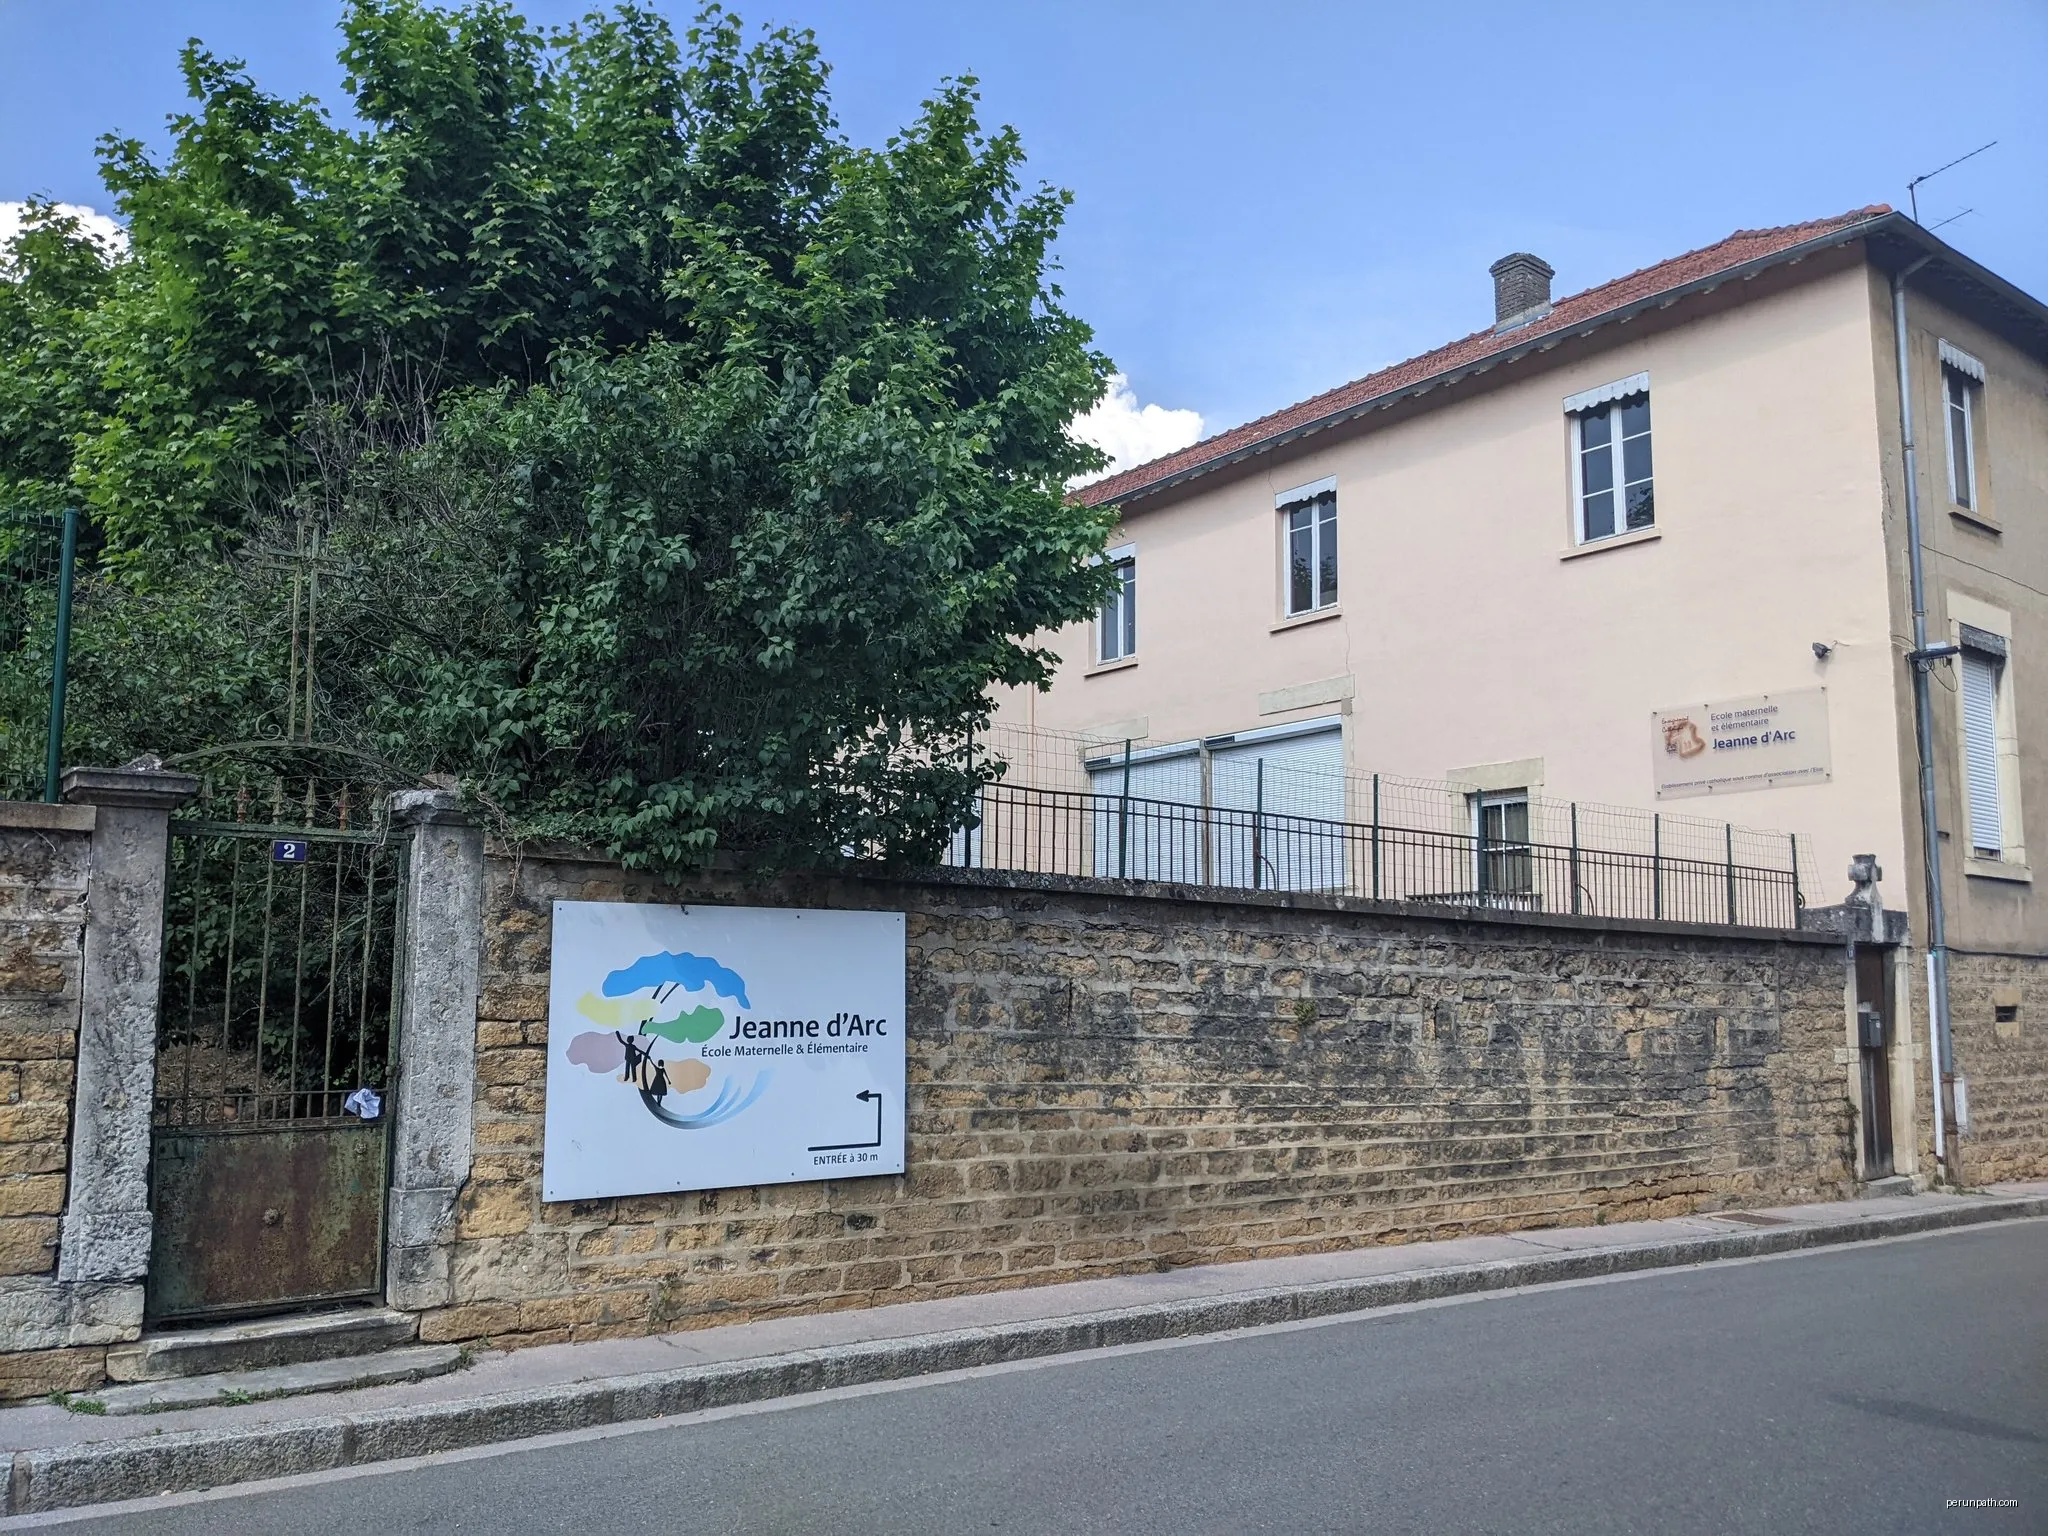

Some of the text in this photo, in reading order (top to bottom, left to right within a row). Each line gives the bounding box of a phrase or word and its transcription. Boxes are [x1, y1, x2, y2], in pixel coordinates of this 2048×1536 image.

[1735, 705, 1778, 718] maternelle
[1713, 730, 1796, 750] Jeanne d'Arc
[283, 844, 296, 859] 2
[729, 1016, 820, 1040] Jeanne
[702, 1041, 868, 1058] École Maternelle & Élémentaire
[814, 1152, 847, 1166] ENTRÉE
[850, 1154, 855, 1163] à
[857, 1153, 868, 1162] 30
